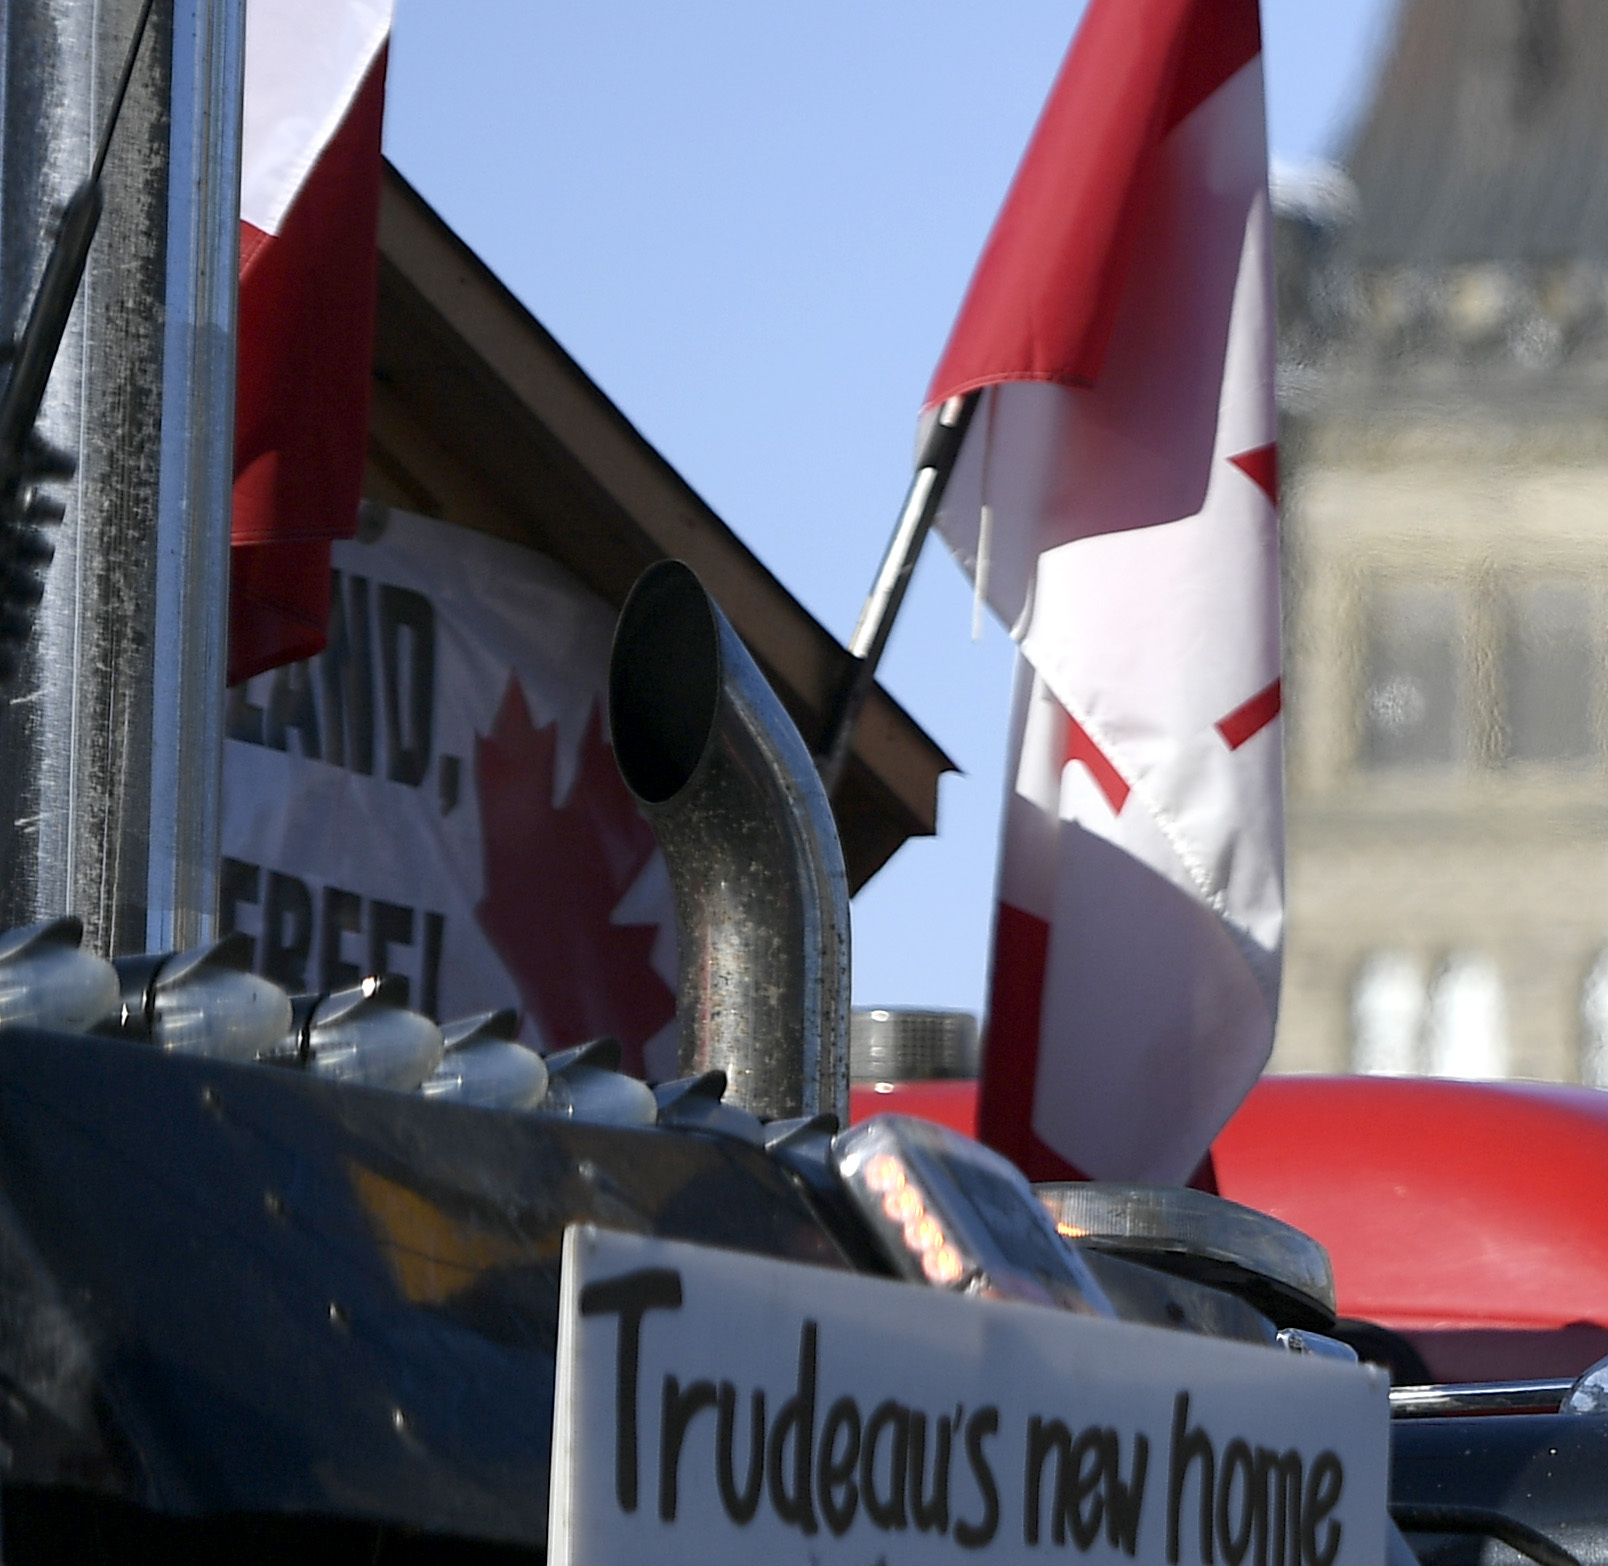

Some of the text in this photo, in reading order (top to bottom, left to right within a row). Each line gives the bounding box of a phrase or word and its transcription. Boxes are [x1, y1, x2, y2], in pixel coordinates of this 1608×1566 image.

[226, 568, 463, 817] AND,
[579, 1267, 1000, 1550] Trudeau's
[1024, 1413, 1148, 1558] new
